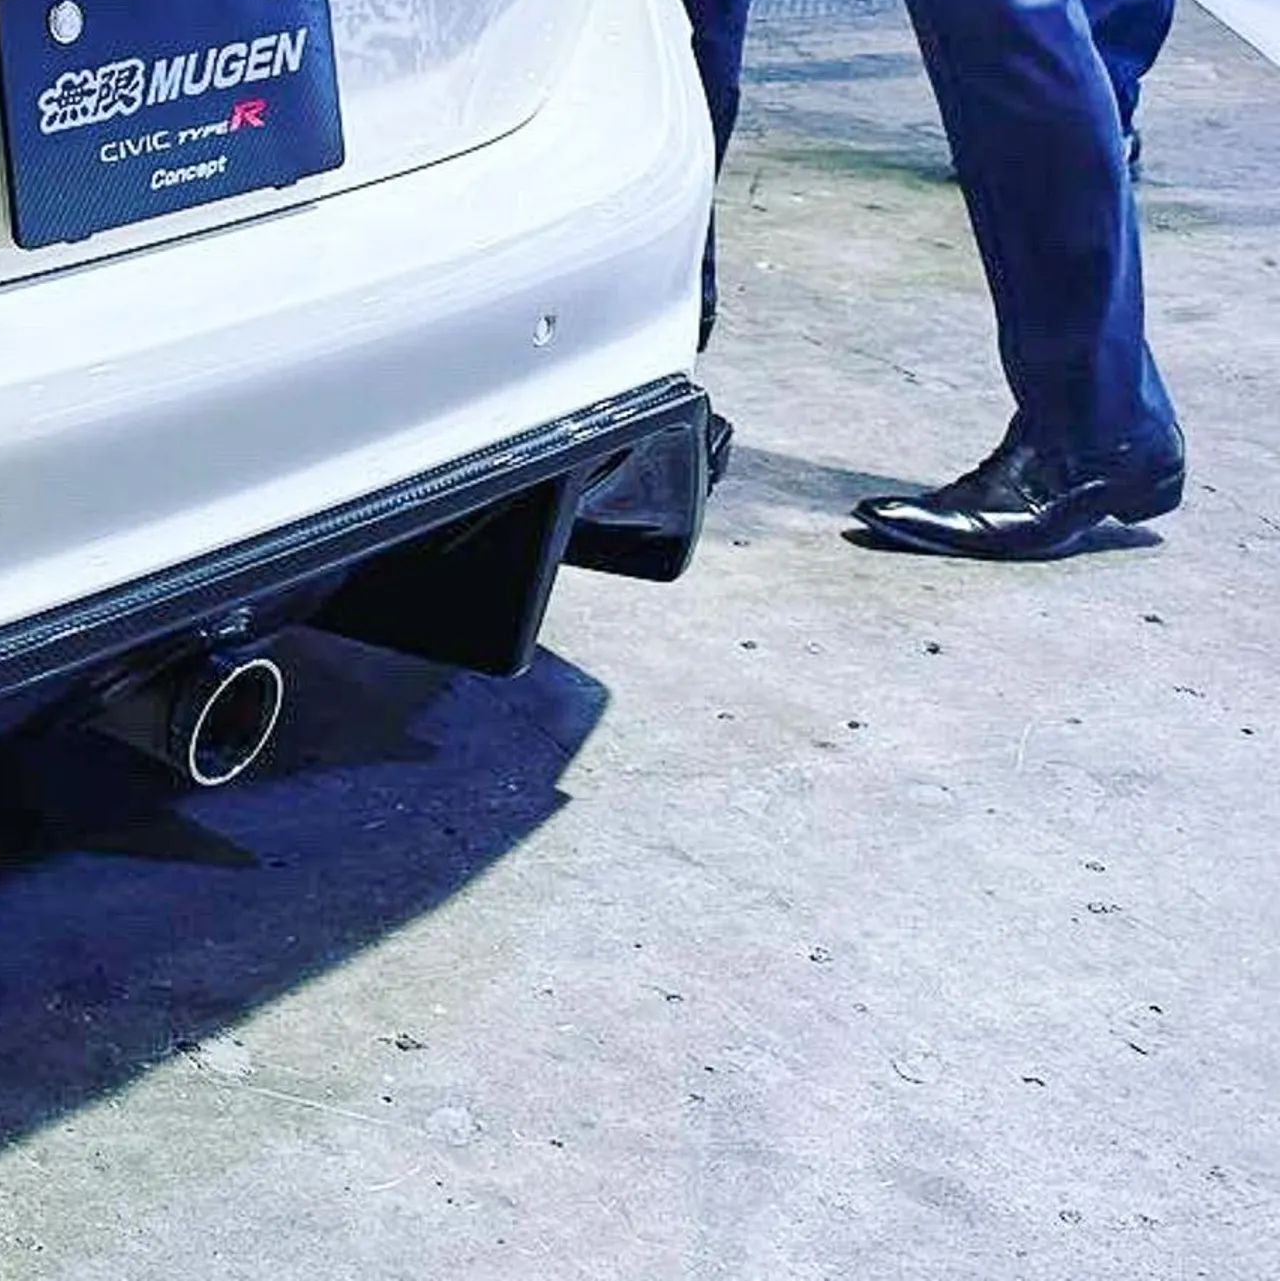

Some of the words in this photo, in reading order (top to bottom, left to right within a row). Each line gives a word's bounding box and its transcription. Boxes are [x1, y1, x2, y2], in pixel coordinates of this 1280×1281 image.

[145, 27, 308, 107] MUGEN
[100, 130, 172, 163] CIVIC
[150, 154, 228, 191] Concept
